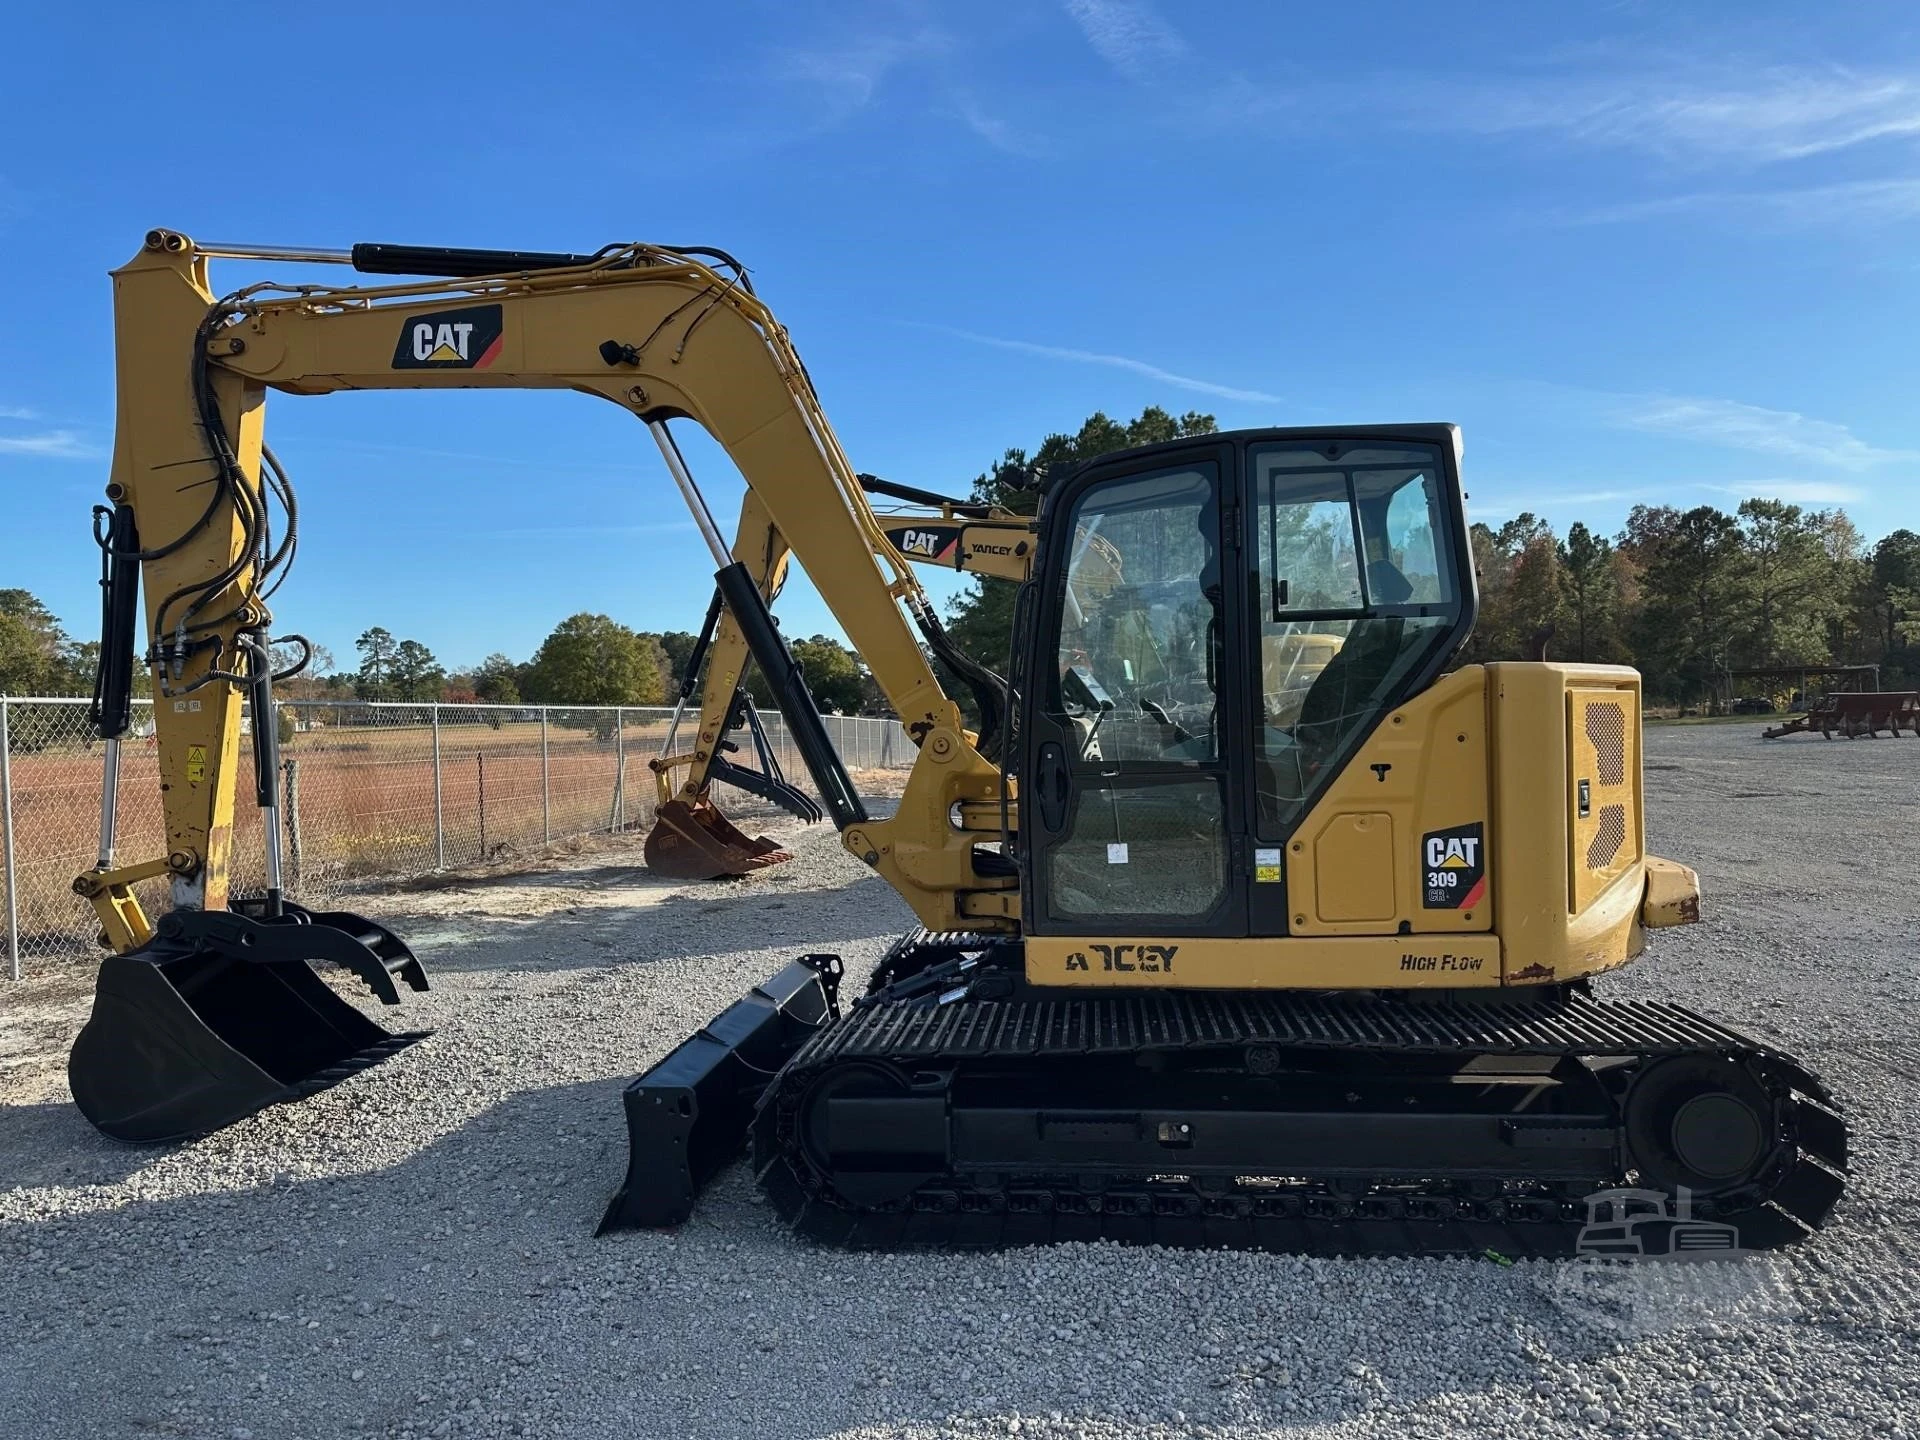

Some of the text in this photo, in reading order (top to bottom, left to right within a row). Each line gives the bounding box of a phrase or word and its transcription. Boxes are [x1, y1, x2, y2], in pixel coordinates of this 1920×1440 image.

[413, 323, 473, 361] CAT
[903, 529, 939, 556] CAT
[972, 543, 1012, 556] YANCEY
[1427, 838, 1479, 868] CAT
[1428, 872, 1457, 887] 309
[1400, 954, 1484, 971] HIGH FLOW
